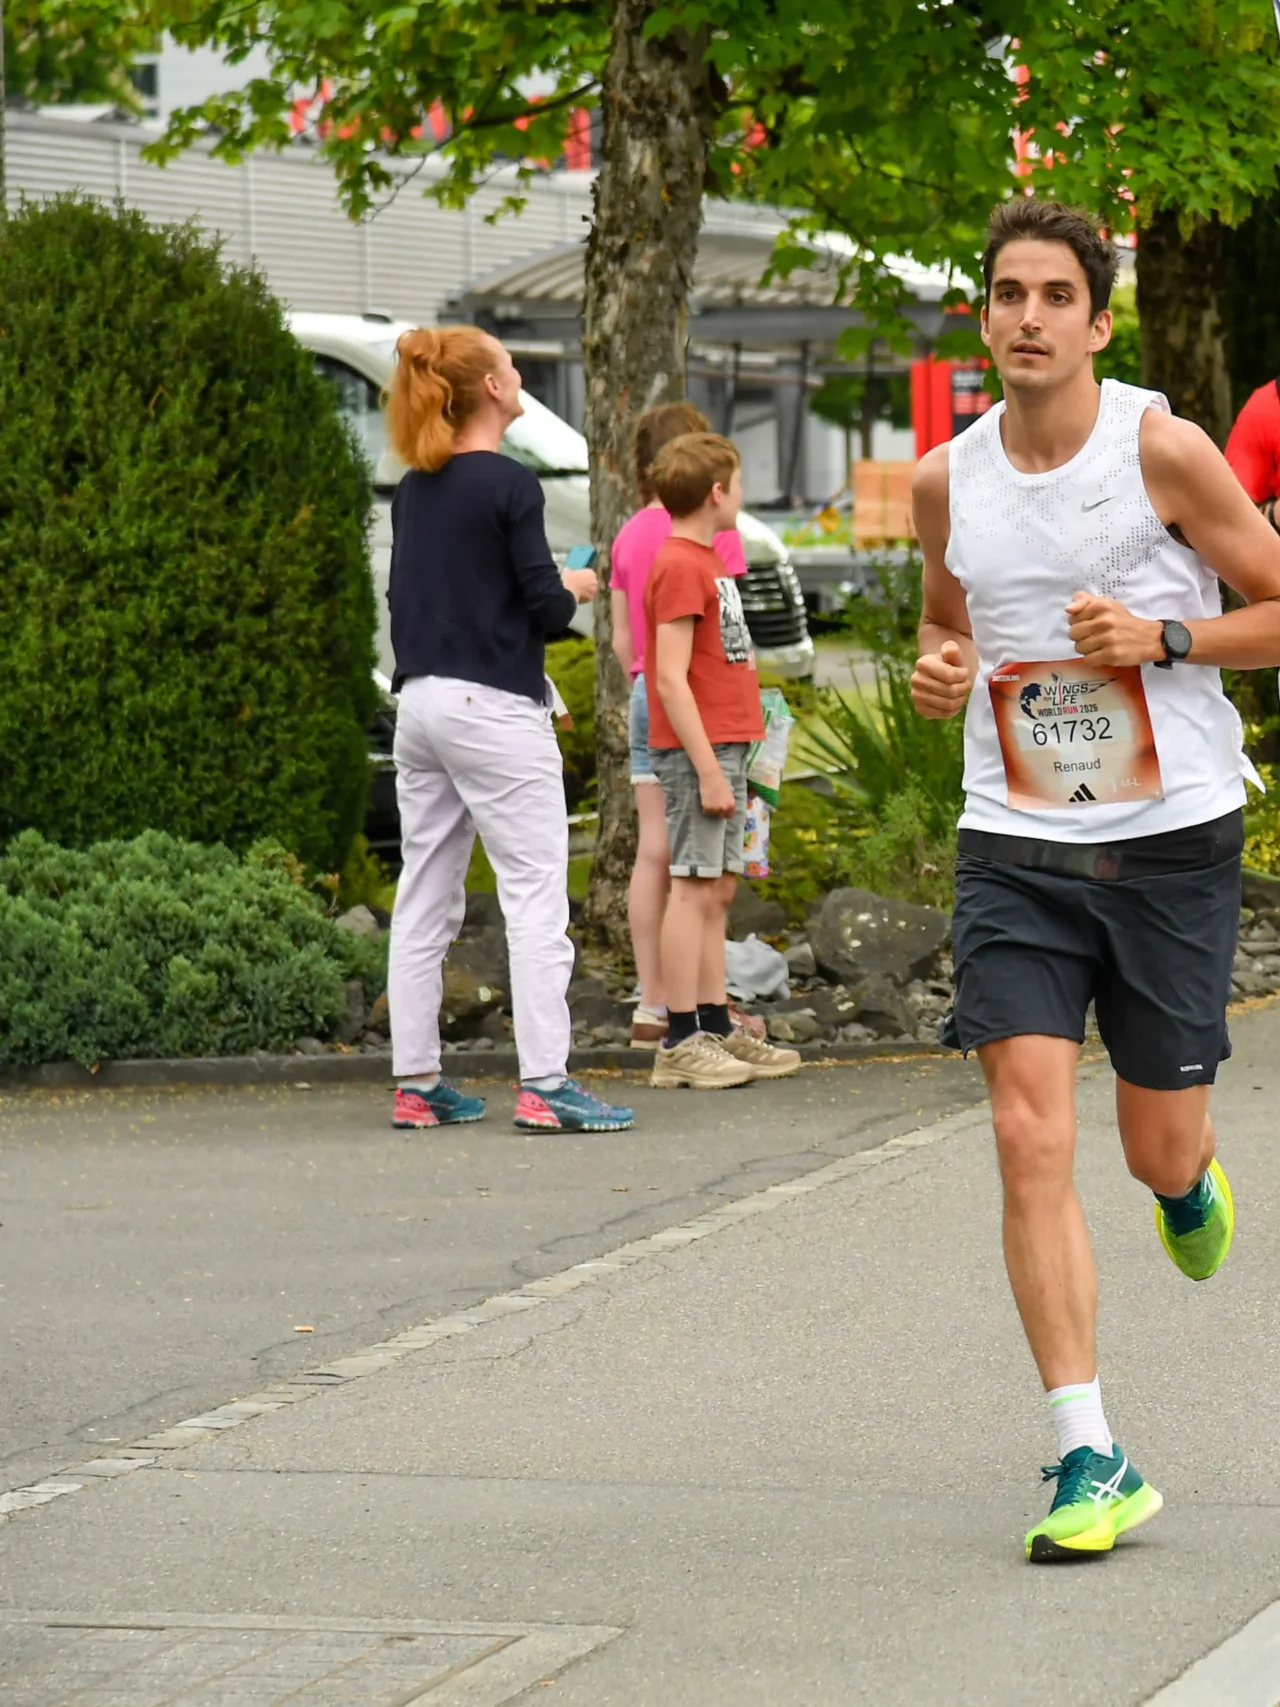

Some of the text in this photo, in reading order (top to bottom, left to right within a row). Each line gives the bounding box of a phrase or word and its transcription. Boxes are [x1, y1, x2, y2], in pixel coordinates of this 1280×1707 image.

[1044, 683, 1088, 696] WINGS
[1052, 694, 1078, 706] LIFE
[1037, 704, 1098, 717] WORLD RUN 2026
[1032, 717, 1113, 746] 61732
[1053, 758, 1101, 773] Renaud
